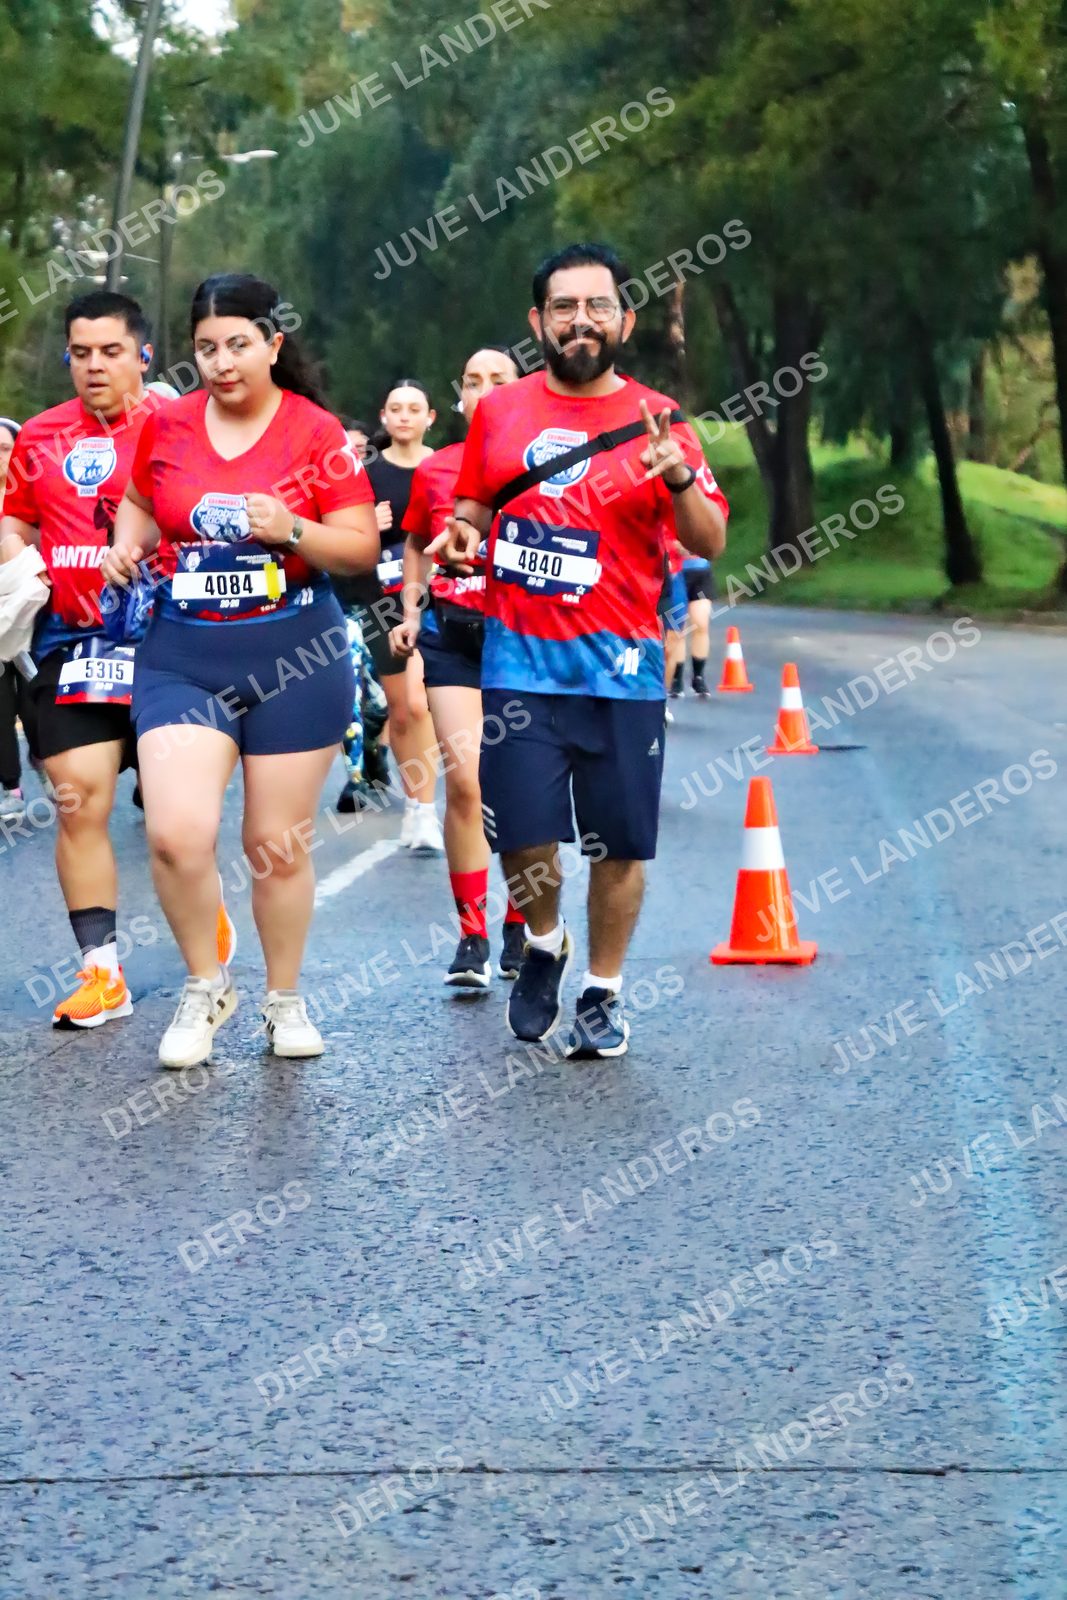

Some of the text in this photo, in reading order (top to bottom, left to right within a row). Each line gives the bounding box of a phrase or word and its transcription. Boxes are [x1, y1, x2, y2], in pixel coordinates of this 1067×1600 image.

[518, 549, 562, 577] 4840
[205, 573, 253, 596] 4084
[85, 660, 124, 680] 5315
